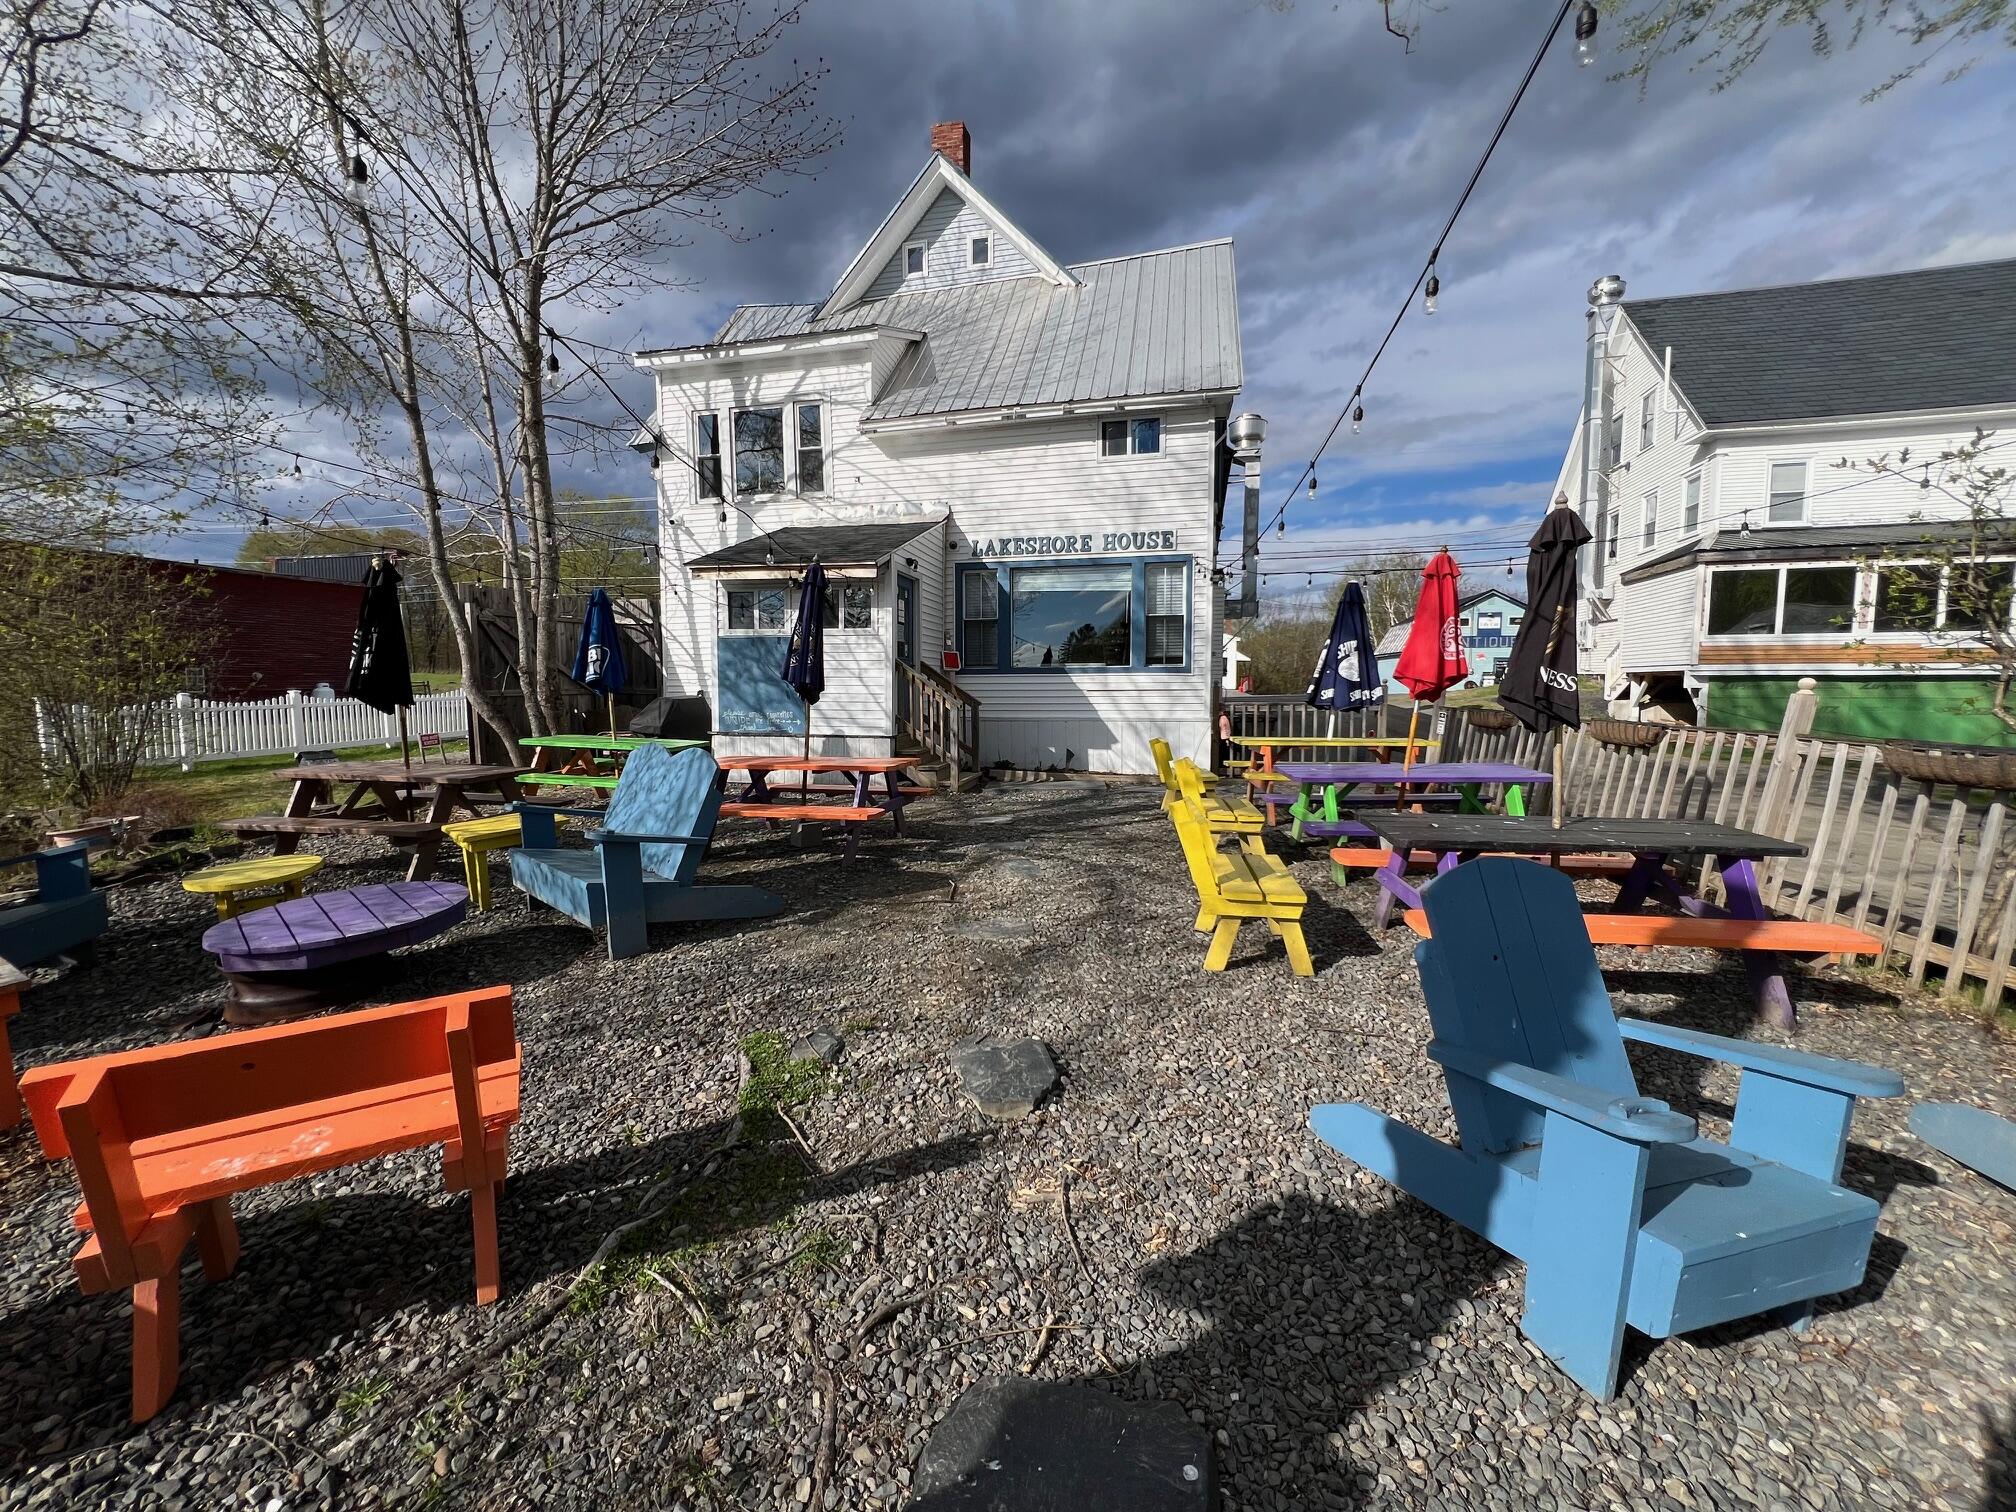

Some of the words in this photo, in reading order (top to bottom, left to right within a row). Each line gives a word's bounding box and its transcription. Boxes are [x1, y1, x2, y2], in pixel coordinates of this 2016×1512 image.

[971, 535, 1092, 557] LAKESHORE
[1103, 531, 1174, 551] HOUSE
[1460, 635, 1517, 648] NTIQUE
